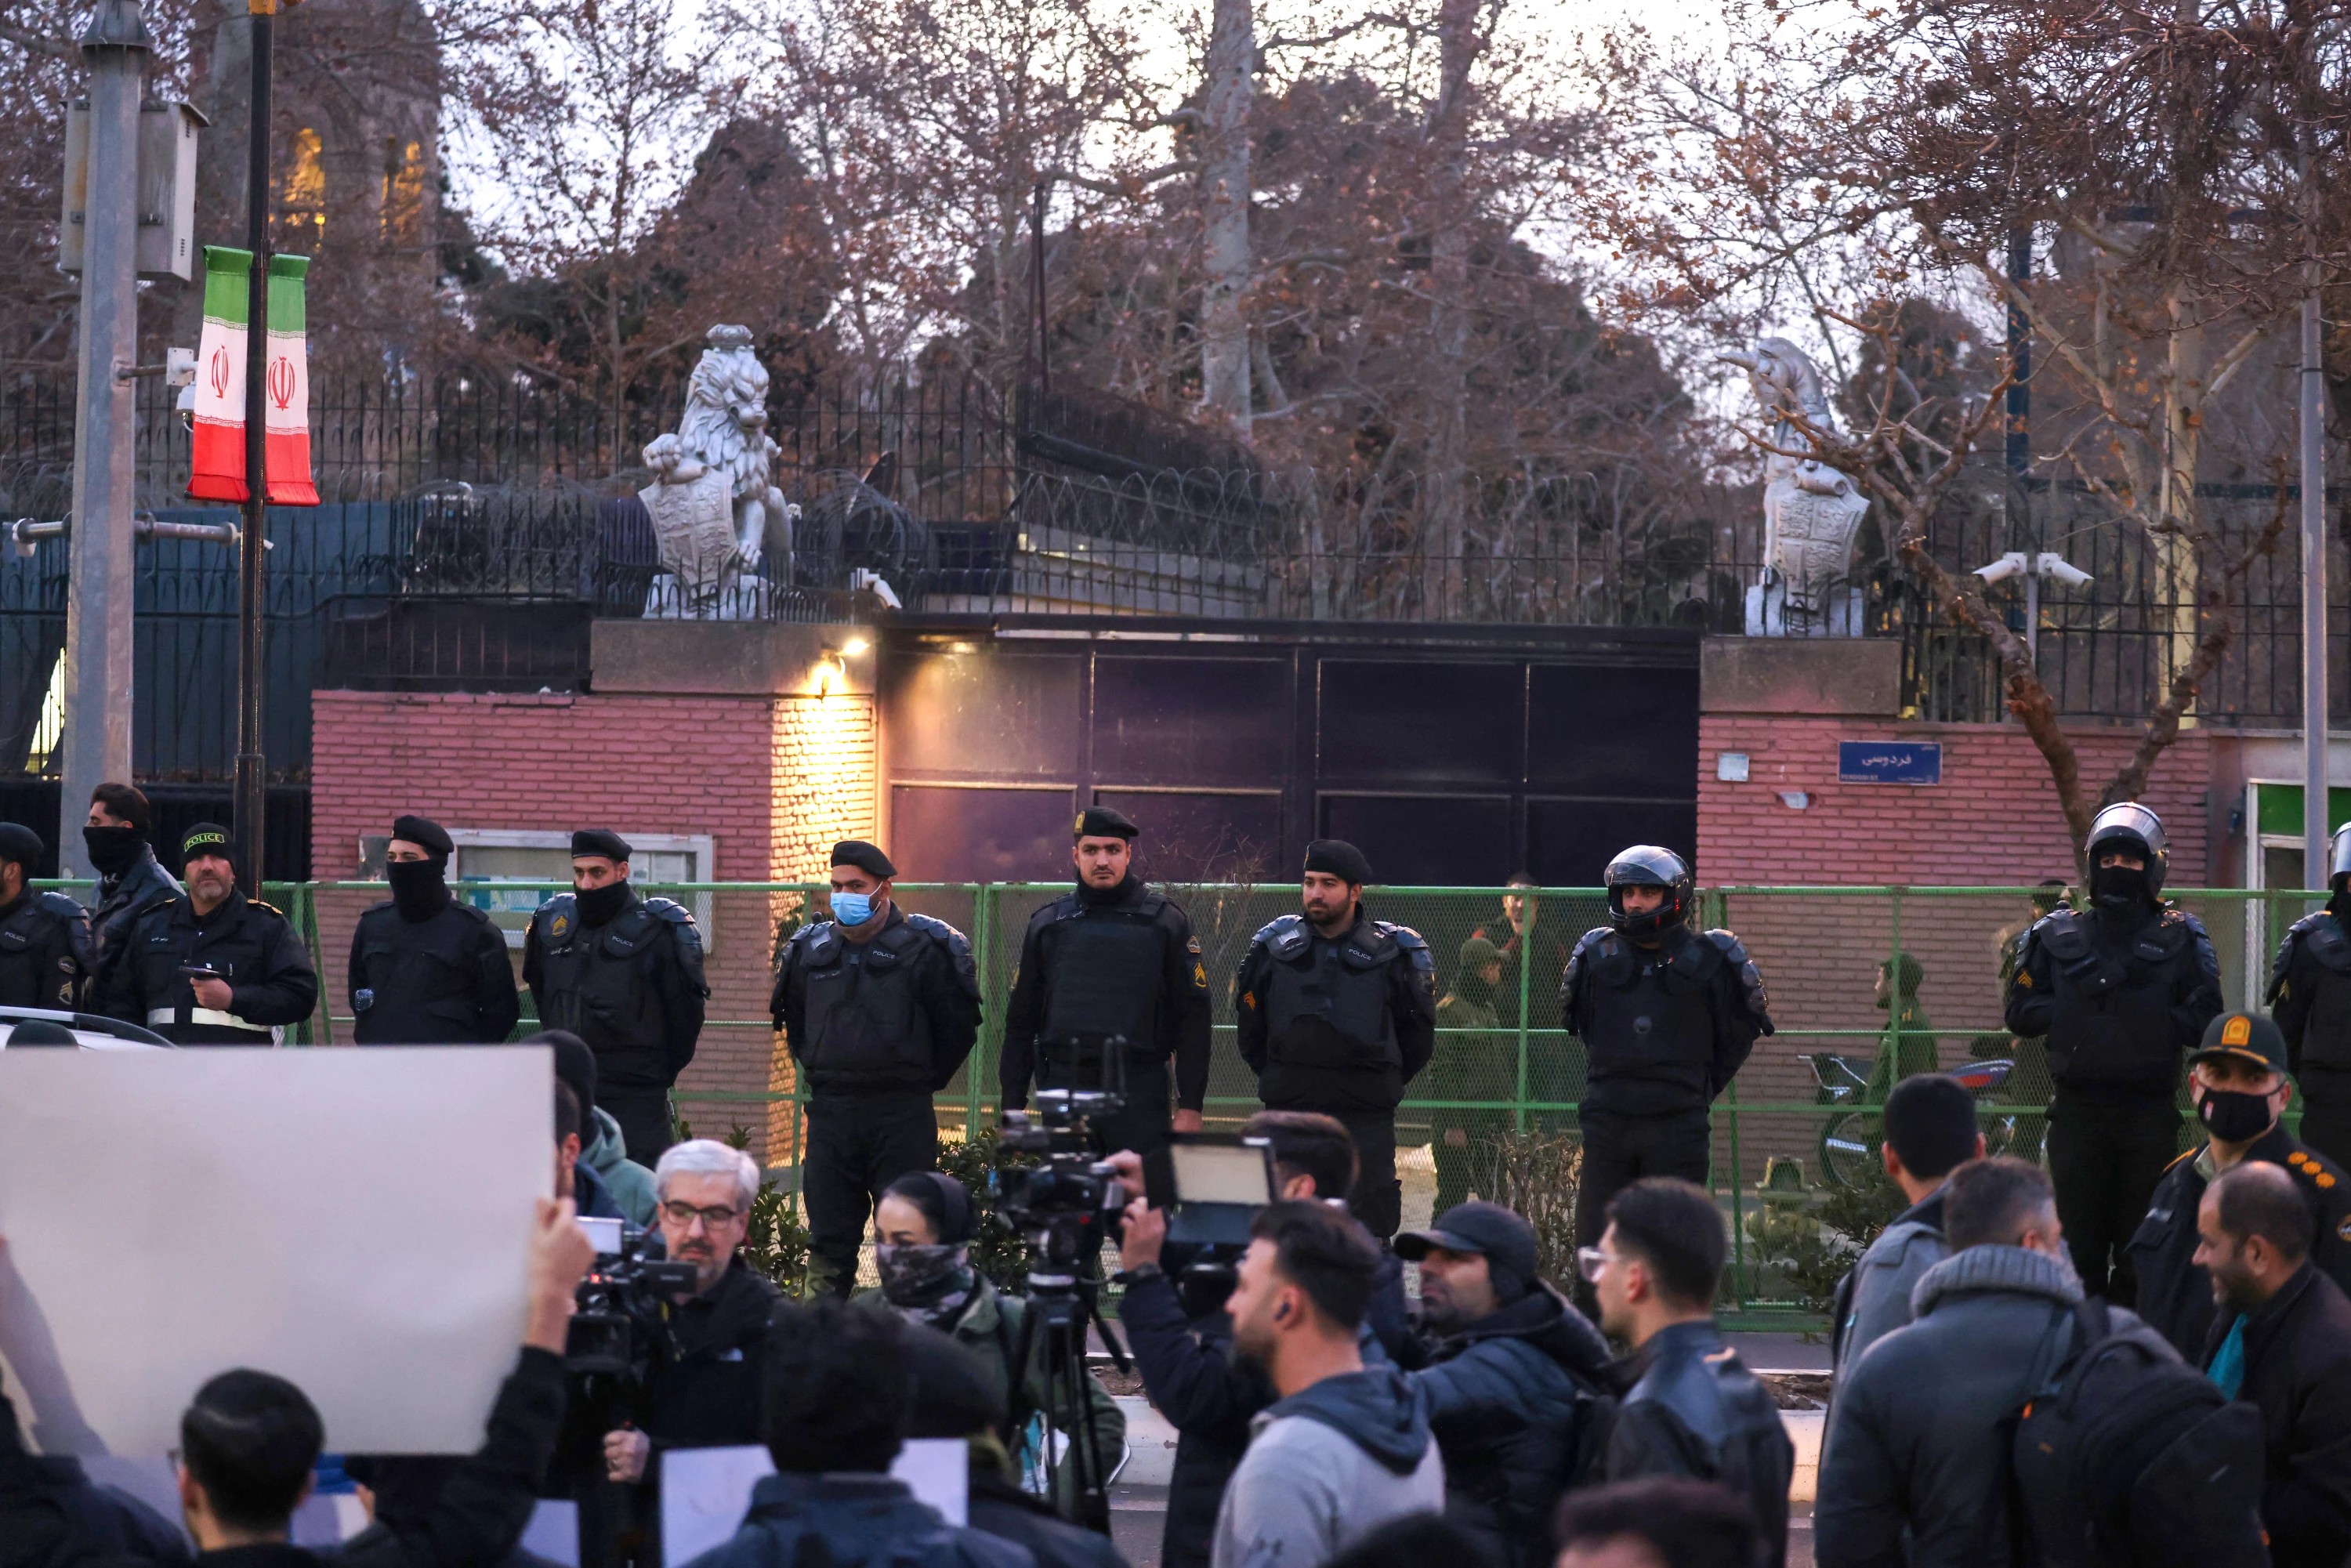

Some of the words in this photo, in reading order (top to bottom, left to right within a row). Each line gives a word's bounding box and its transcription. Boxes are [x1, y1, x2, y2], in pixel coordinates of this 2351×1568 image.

[1861, 753, 1912, 767] فردوسی
[187, 834, 220, 848] POLICE
[5, 931, 26, 942] POLICE
[612, 936, 634, 947] POLICE
[872, 950, 896, 959] POLICE
[1349, 948, 1372, 961] POLICE
